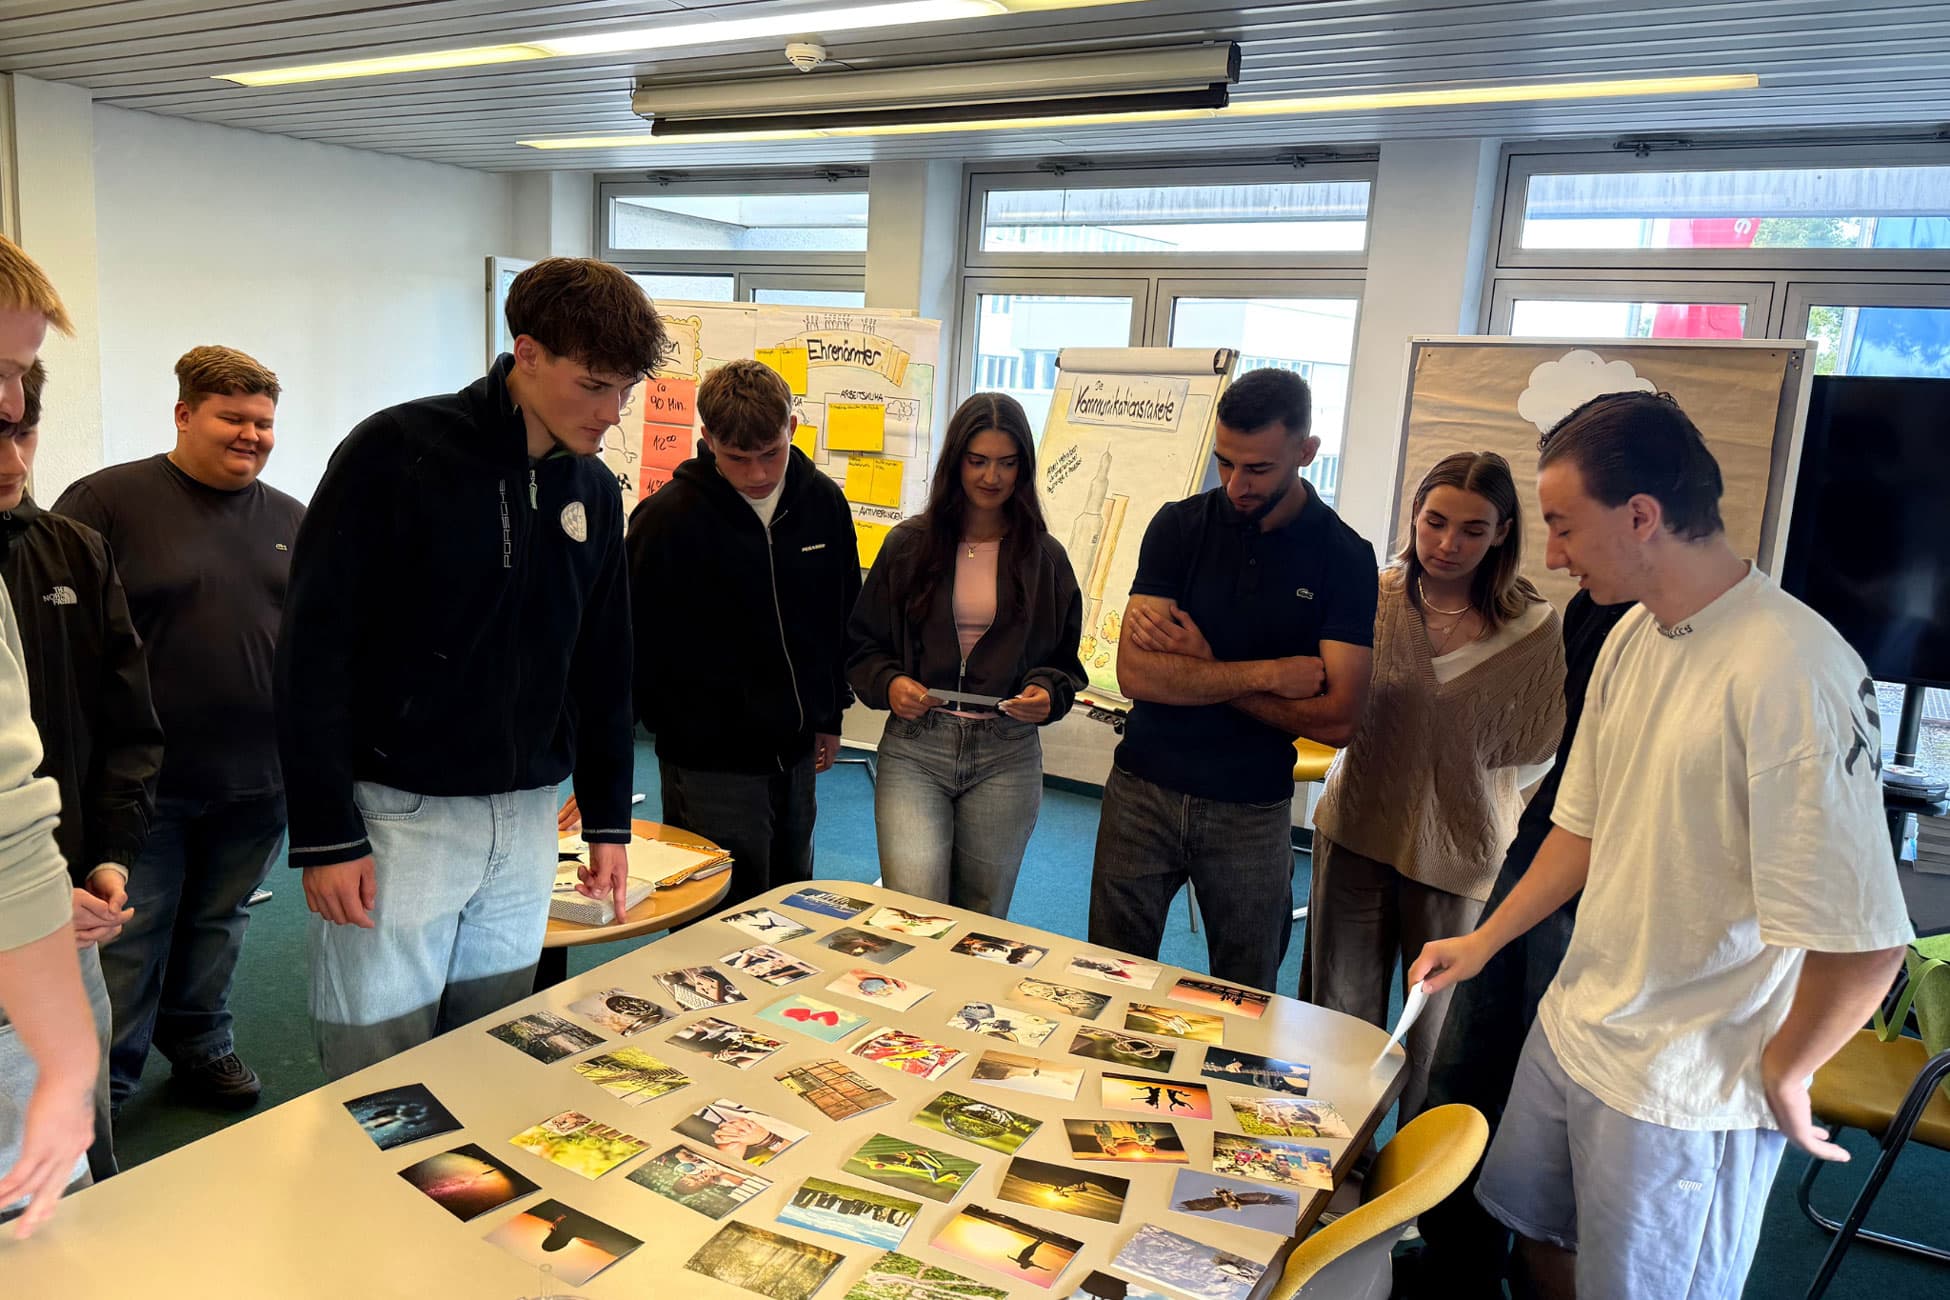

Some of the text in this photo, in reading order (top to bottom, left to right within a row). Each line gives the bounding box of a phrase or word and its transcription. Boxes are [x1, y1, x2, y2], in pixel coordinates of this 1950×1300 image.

[806, 336, 881, 366] Ehrenämter
[651, 395, 665, 410] 90
[500, 479, 512, 568] PORSCHE
